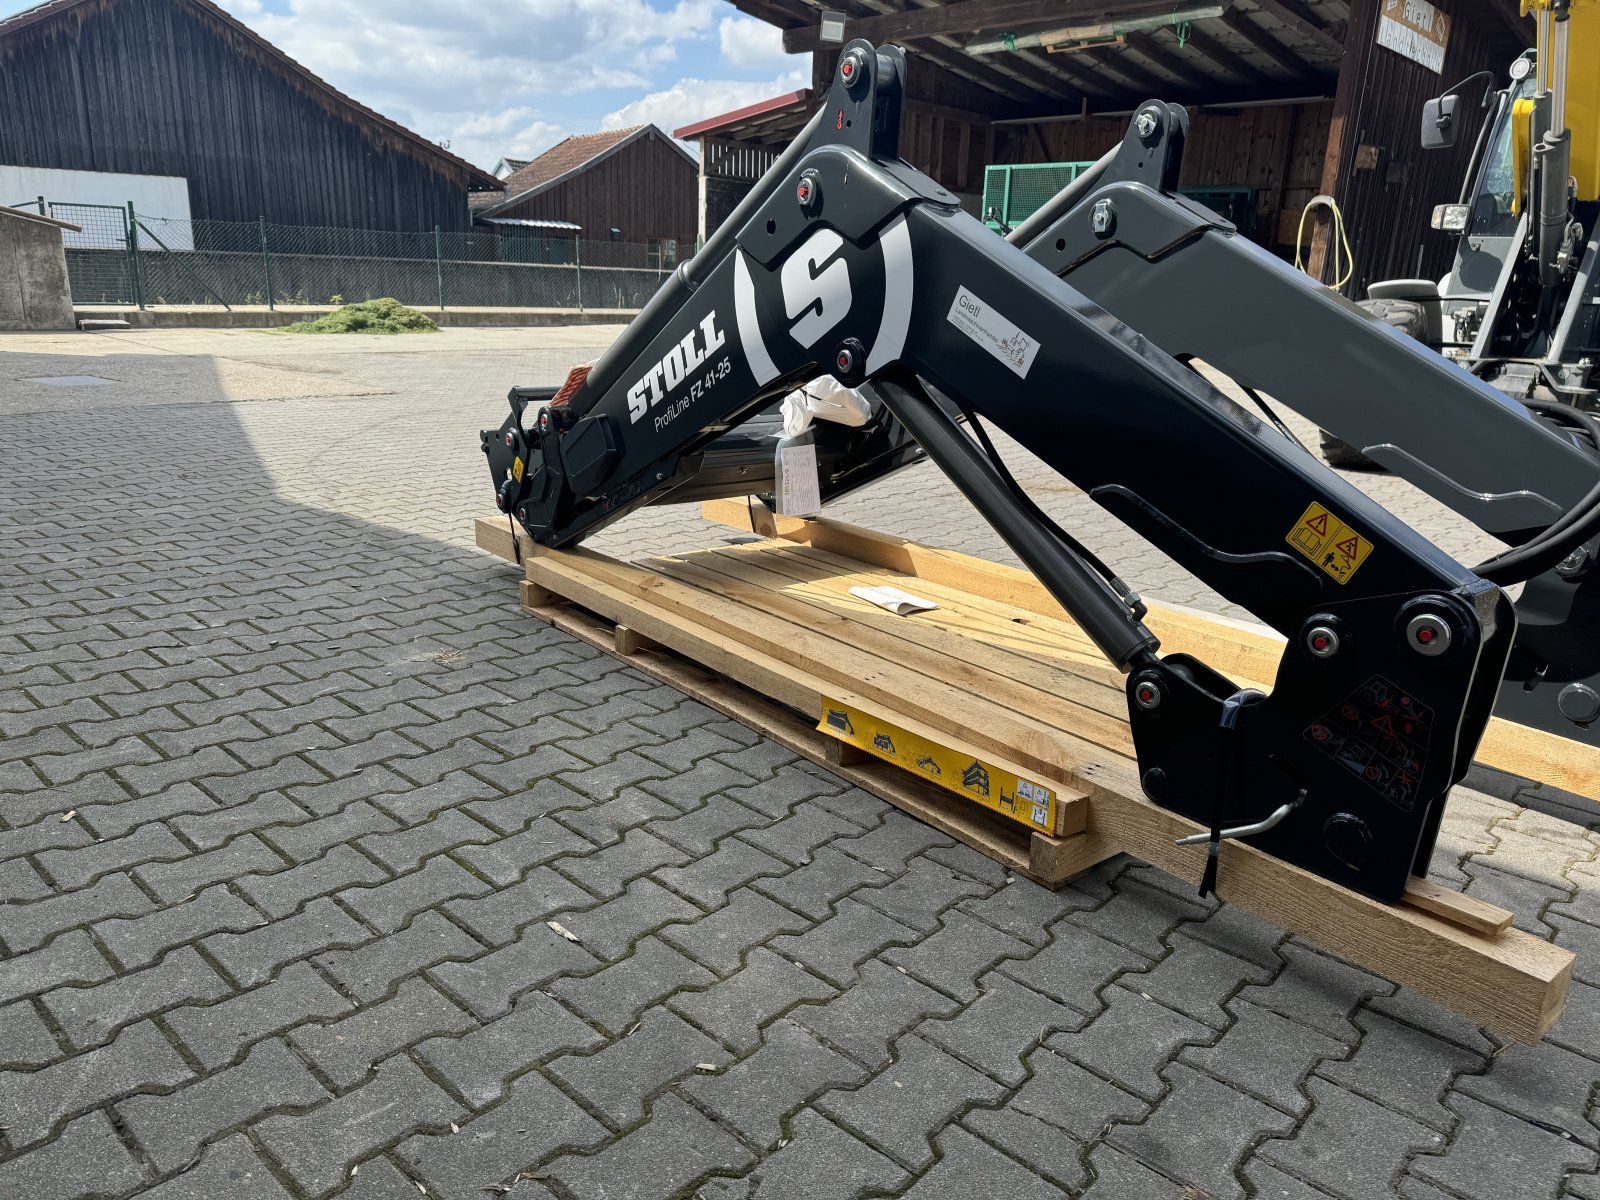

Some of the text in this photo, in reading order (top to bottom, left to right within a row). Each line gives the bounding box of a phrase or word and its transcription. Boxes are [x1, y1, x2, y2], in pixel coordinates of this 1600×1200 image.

[959, 294, 981, 317] Gietl
[626, 309, 726, 425] STOLL
[654, 356, 731, 433] ProfiLine FZ 41-25
